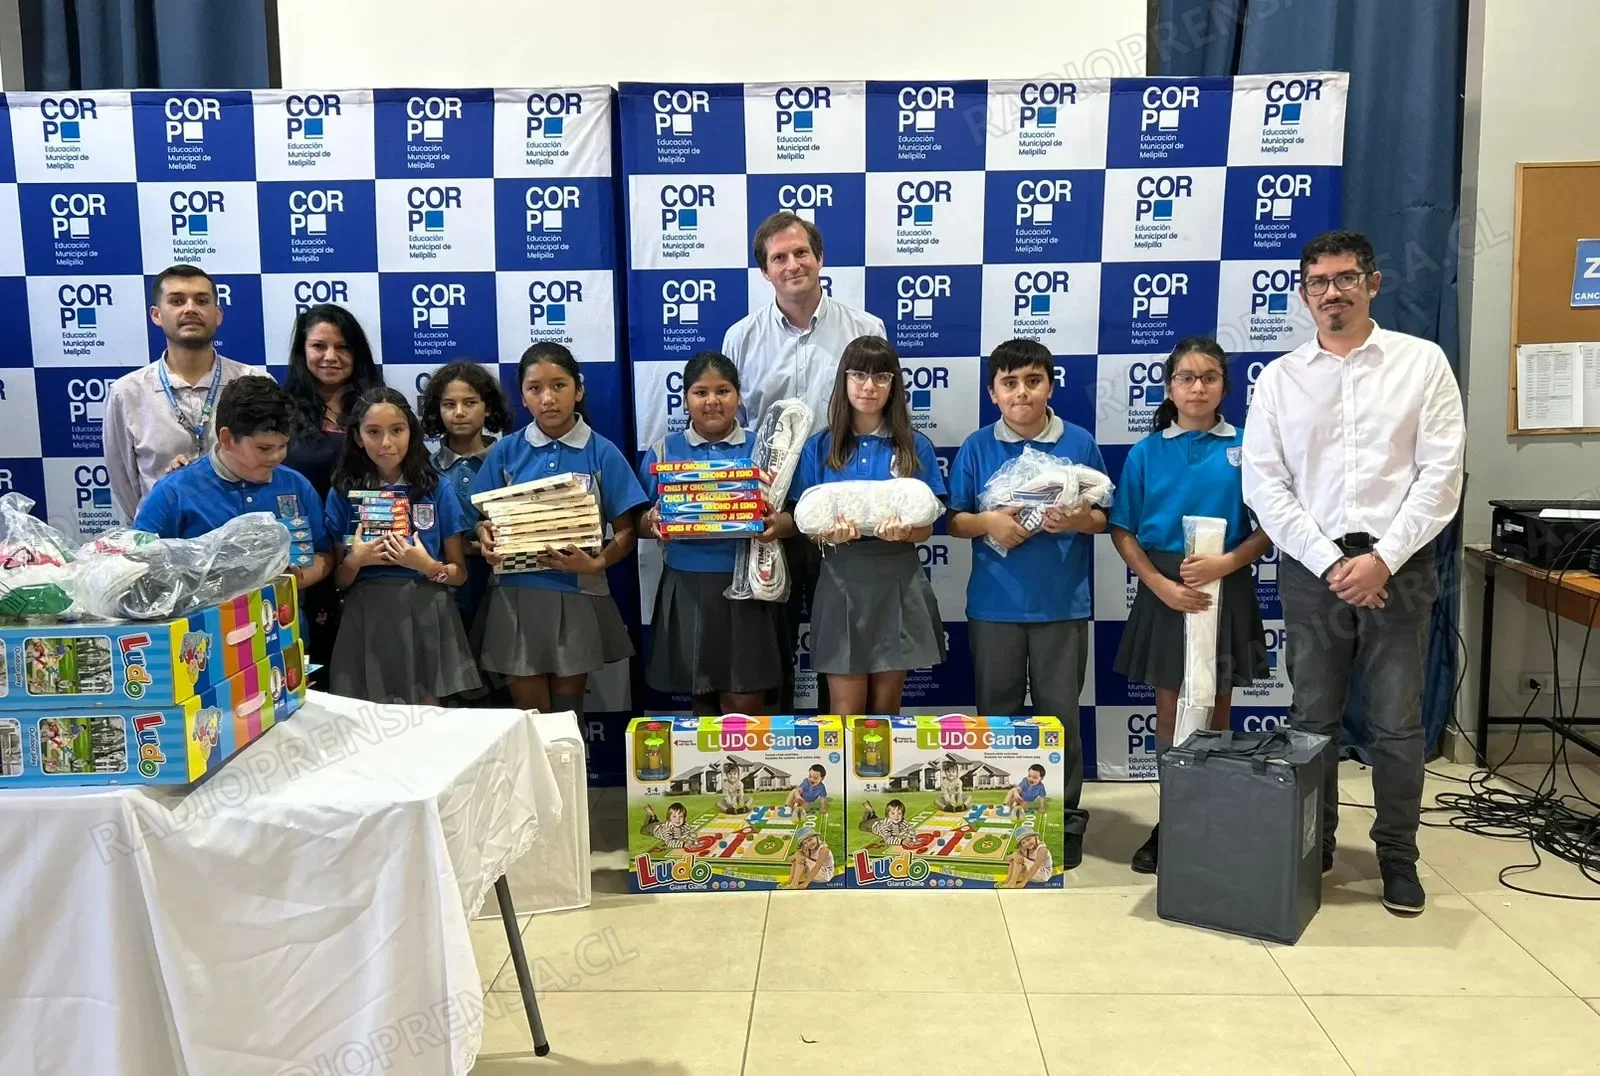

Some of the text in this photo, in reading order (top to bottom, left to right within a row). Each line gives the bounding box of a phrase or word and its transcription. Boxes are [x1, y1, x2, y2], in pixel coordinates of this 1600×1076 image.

[654, 90, 710, 112] COR
[775, 87, 831, 109] COR
[898, 87, 954, 109] COR
[1020, 82, 1076, 105] COR
[1143, 86, 1199, 108] COR
[1266, 79, 1322, 102] COR
[40, 98, 97, 120] COR
[165, 98, 220, 120] COR
[287, 95, 342, 118] COR
[407, 97, 462, 119] COR
[527, 93, 582, 116] COR
[1264, 104, 1280, 126] P
[527, 117, 542, 138] P
[656, 113, 671, 135] P
[776, 111, 792, 132] P
[899, 110, 914, 132] P
[1020, 106, 1036, 128] P
[1142, 110, 1158, 131] P
[43, 121, 58, 142] P
[166, 121, 182, 142] P
[287, 118, 302, 139] P
[408, 120, 422, 141] P
[46, 154, 79, 162] Municipal
[658, 147, 690, 156] Municipal
[898, 144, 931, 152] Municipal
[46, 162, 74, 171] Melipilla
[658, 156, 685, 164] Melipilla
[661, 185, 715, 207] COR
[779, 184, 832, 207] COR
[897, 181, 951, 203] COR
[1017, 180, 1072, 202] COR
[1137, 176, 1192, 198] COR
[1258, 174, 1312, 197] COR
[51, 194, 106, 216] COR
[170, 191, 224, 213] COR
[289, 190, 344, 213] COR
[408, 187, 461, 209] COR
[526, 186, 579, 209] COR
[662, 209, 677, 230] P
[898, 205, 912, 226] P
[1017, 204, 1032, 225] P
[1136, 200, 1152, 221] P
[1256, 198, 1272, 220] P
[53, 218, 68, 238] P
[172, 214, 187, 236] P
[290, 214, 306, 235] P
[408, 210, 423, 232] P
[526, 210, 541, 232] P
[1016, 237, 1048, 245] Municipal
[1254, 232, 1286, 240] Municipal
[292, 255, 319, 263] Melipilla
[1016, 246, 1042, 254] Melipilla
[295, 281, 348, 303] COR
[529, 281, 582, 303] COR
[662, 280, 716, 302] COR
[898, 275, 950, 298] COR
[1015, 271, 1069, 293] COR
[1134, 274, 1188, 296] COR
[1252, 270, 1300, 292] COR
[58, 284, 112, 306] COR
[412, 284, 465, 306] COR
[1014, 295, 1030, 316] P
[1252, 293, 1267, 314] P
[60, 308, 76, 328] P
[413, 307, 428, 328] P
[530, 304, 545, 325] P
[663, 304, 678, 324] P
[898, 299, 912, 320] P
[1133, 297, 1148, 318] P
[70, 402, 85, 422] P
[77, 488, 92, 508] P
[79, 520, 110, 528] Municipal
[118, 634, 151, 698] Ludo
[133, 714, 165, 777] Ludo
[708, 734, 758, 748] LUDO
[763, 732, 812, 747] Game
[927, 732, 977, 747] LUDO
[982, 731, 1032, 746] Game
[636, 854, 712, 890] Ludo
[854, 850, 930, 886] Ludo
